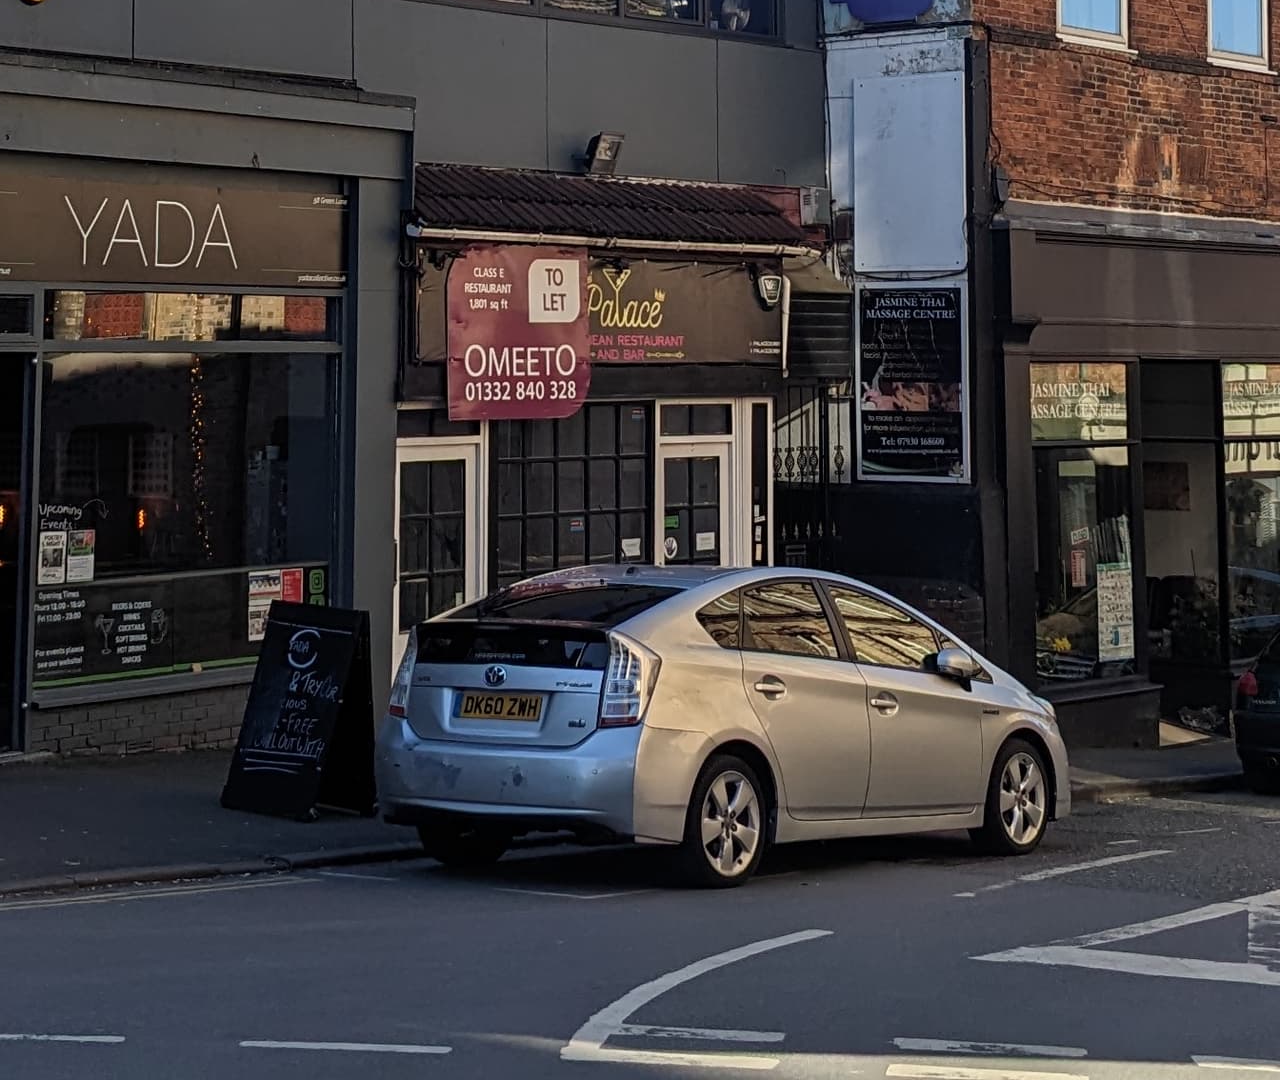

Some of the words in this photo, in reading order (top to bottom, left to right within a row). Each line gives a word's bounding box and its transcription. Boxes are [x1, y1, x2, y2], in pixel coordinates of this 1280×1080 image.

[65, 195, 237, 270] YADA
[473, 267, 497, 277] CLASS
[499, 268, 504, 277] E
[545, 268, 564, 286] TO
[464, 283, 512, 294] RESTAURANT
[470, 299, 487, 310] 1,801
[490, 302, 499, 311] sq
[500, 299, 508, 309] ft
[543, 293, 566, 311] LET
[587, 281, 663, 328] Palace
[875, 297, 918, 307] JASMINE
[920, 297, 945, 307] THAI
[866, 309, 910, 319] MASSAGE
[913, 309, 955, 318] CENTRE
[589, 335, 613, 346] EAN
[617, 335, 685, 346] RESTAURANT
[464, 344, 576, 377] OMEETO
[597, 350, 619, 360] AND
[624, 349, 644, 360] BAR
[465, 381, 511, 400] 01332
[516, 381, 544, 400] 840
[550, 380, 576, 399] 328
[1031, 383, 1079, 399] JASMINE
[1080, 383, 1109, 397] THAI
[1230, 383, 1269, 397] JASMINE
[1075, 403, 1120, 418] CENTRE
[39, 503, 82, 520] Upcoming
[39, 592, 62, 601] Opening
[63, 590, 79, 598] Times
[118, 623, 145, 632] COCKTAILS
[115, 635, 128, 643] SOFT
[35, 649, 44, 657] For
[46, 648, 65, 656] events
[66, 646, 84, 655] please
[117, 646, 127, 654] HOT
[122, 655, 141, 664] SNACKS
[289, 671, 301, 692] &
[301, 670, 321, 697] TRY
[464, 696, 504, 714] DK60
[507, 698, 538, 717] ZWH
